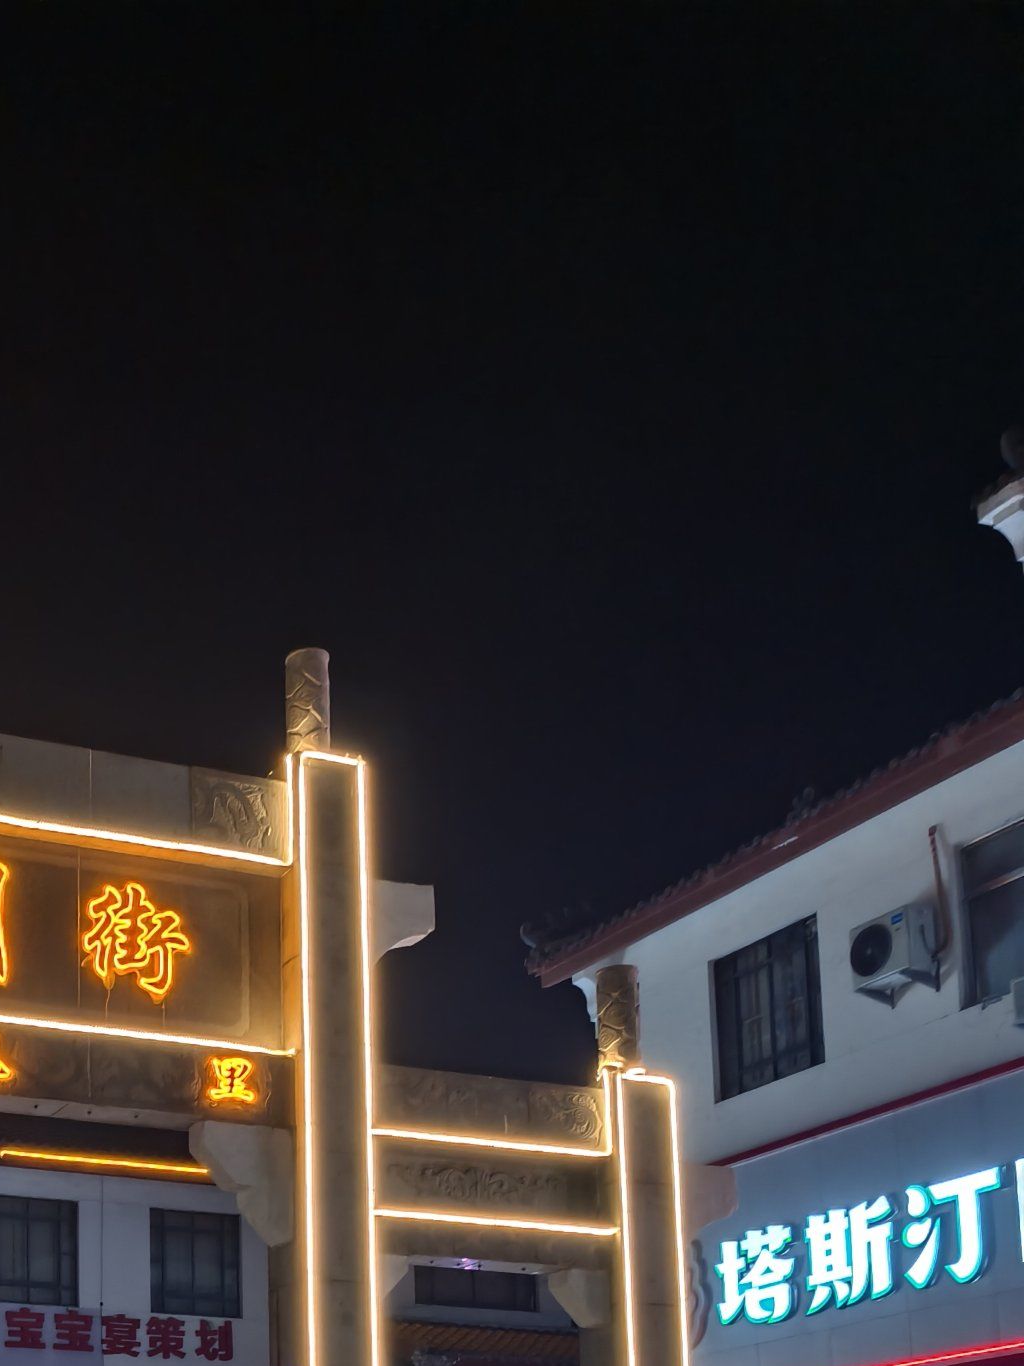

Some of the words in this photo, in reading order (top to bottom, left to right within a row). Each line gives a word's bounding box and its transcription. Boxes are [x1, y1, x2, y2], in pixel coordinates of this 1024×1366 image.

[714, 1158, 1024, 1326] 塔斯汀
[4, 1307, 234, 1362] 宝宝宴策划
